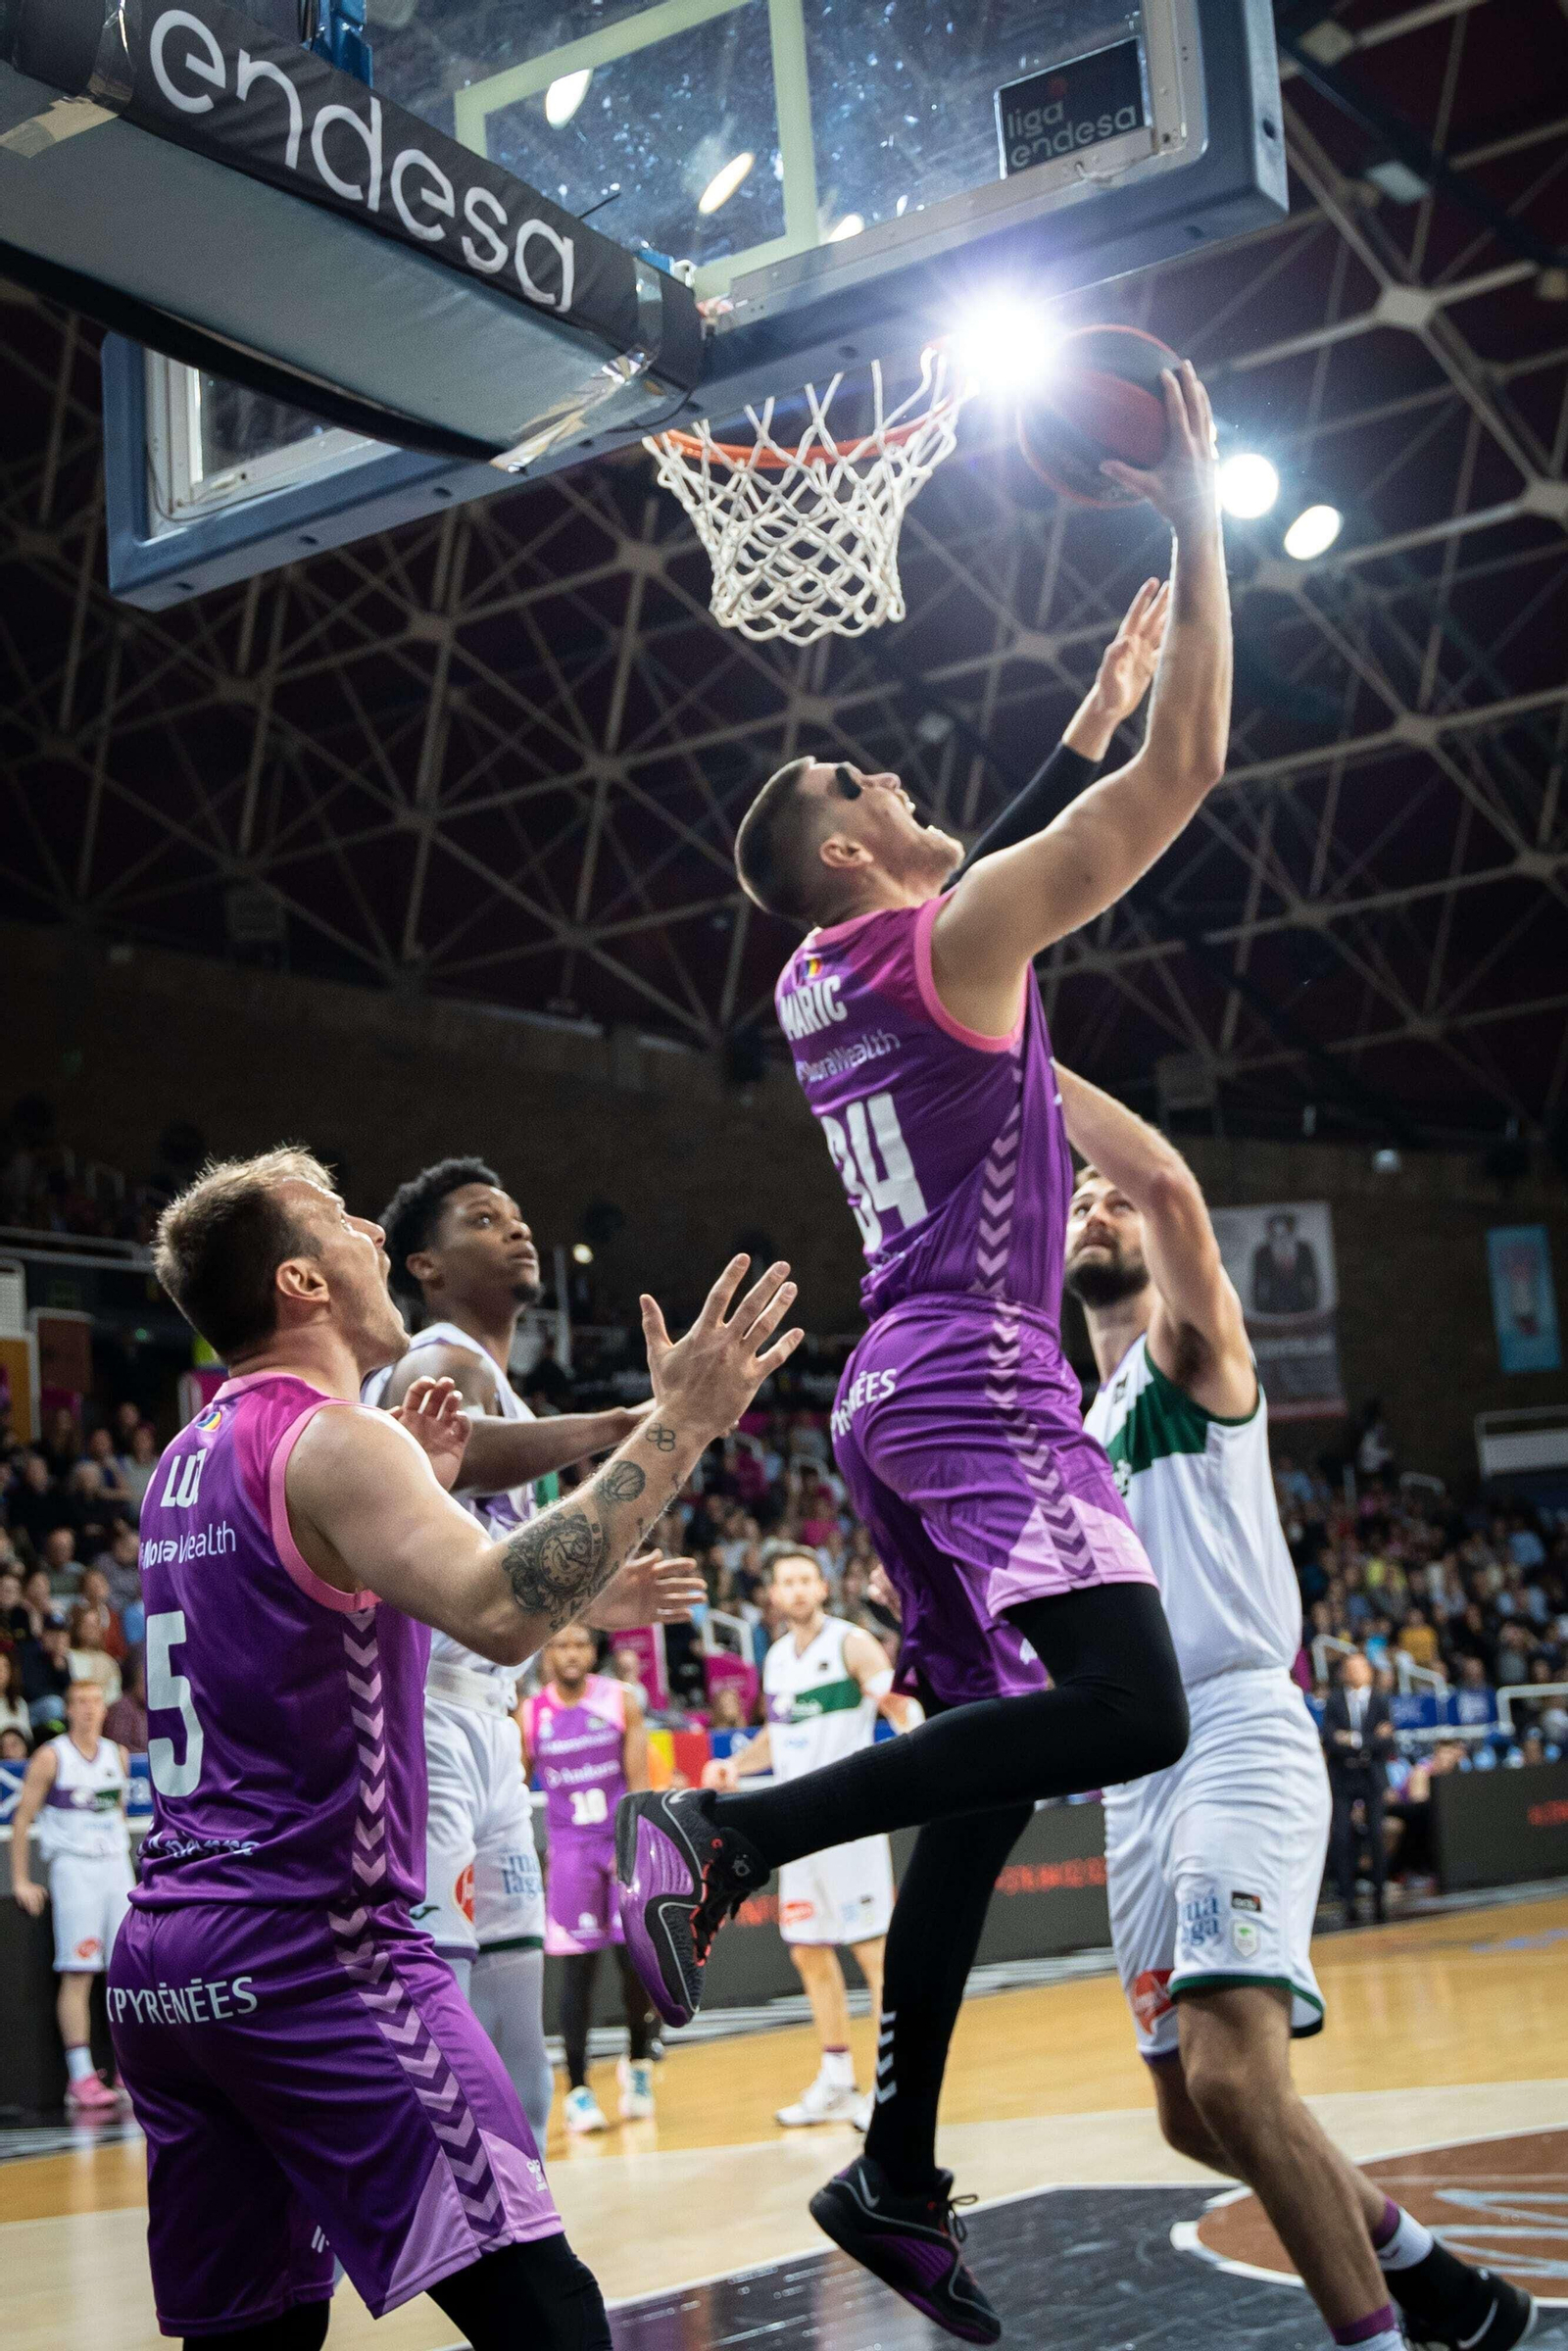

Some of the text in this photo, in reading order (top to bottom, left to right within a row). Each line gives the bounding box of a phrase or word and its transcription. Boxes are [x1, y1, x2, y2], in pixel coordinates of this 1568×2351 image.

[150, 9, 575, 312] endesa
[1006, 100, 1064, 139] liga
[1010, 105, 1138, 168] endesa
[146, 1610, 204, 1797] 5
